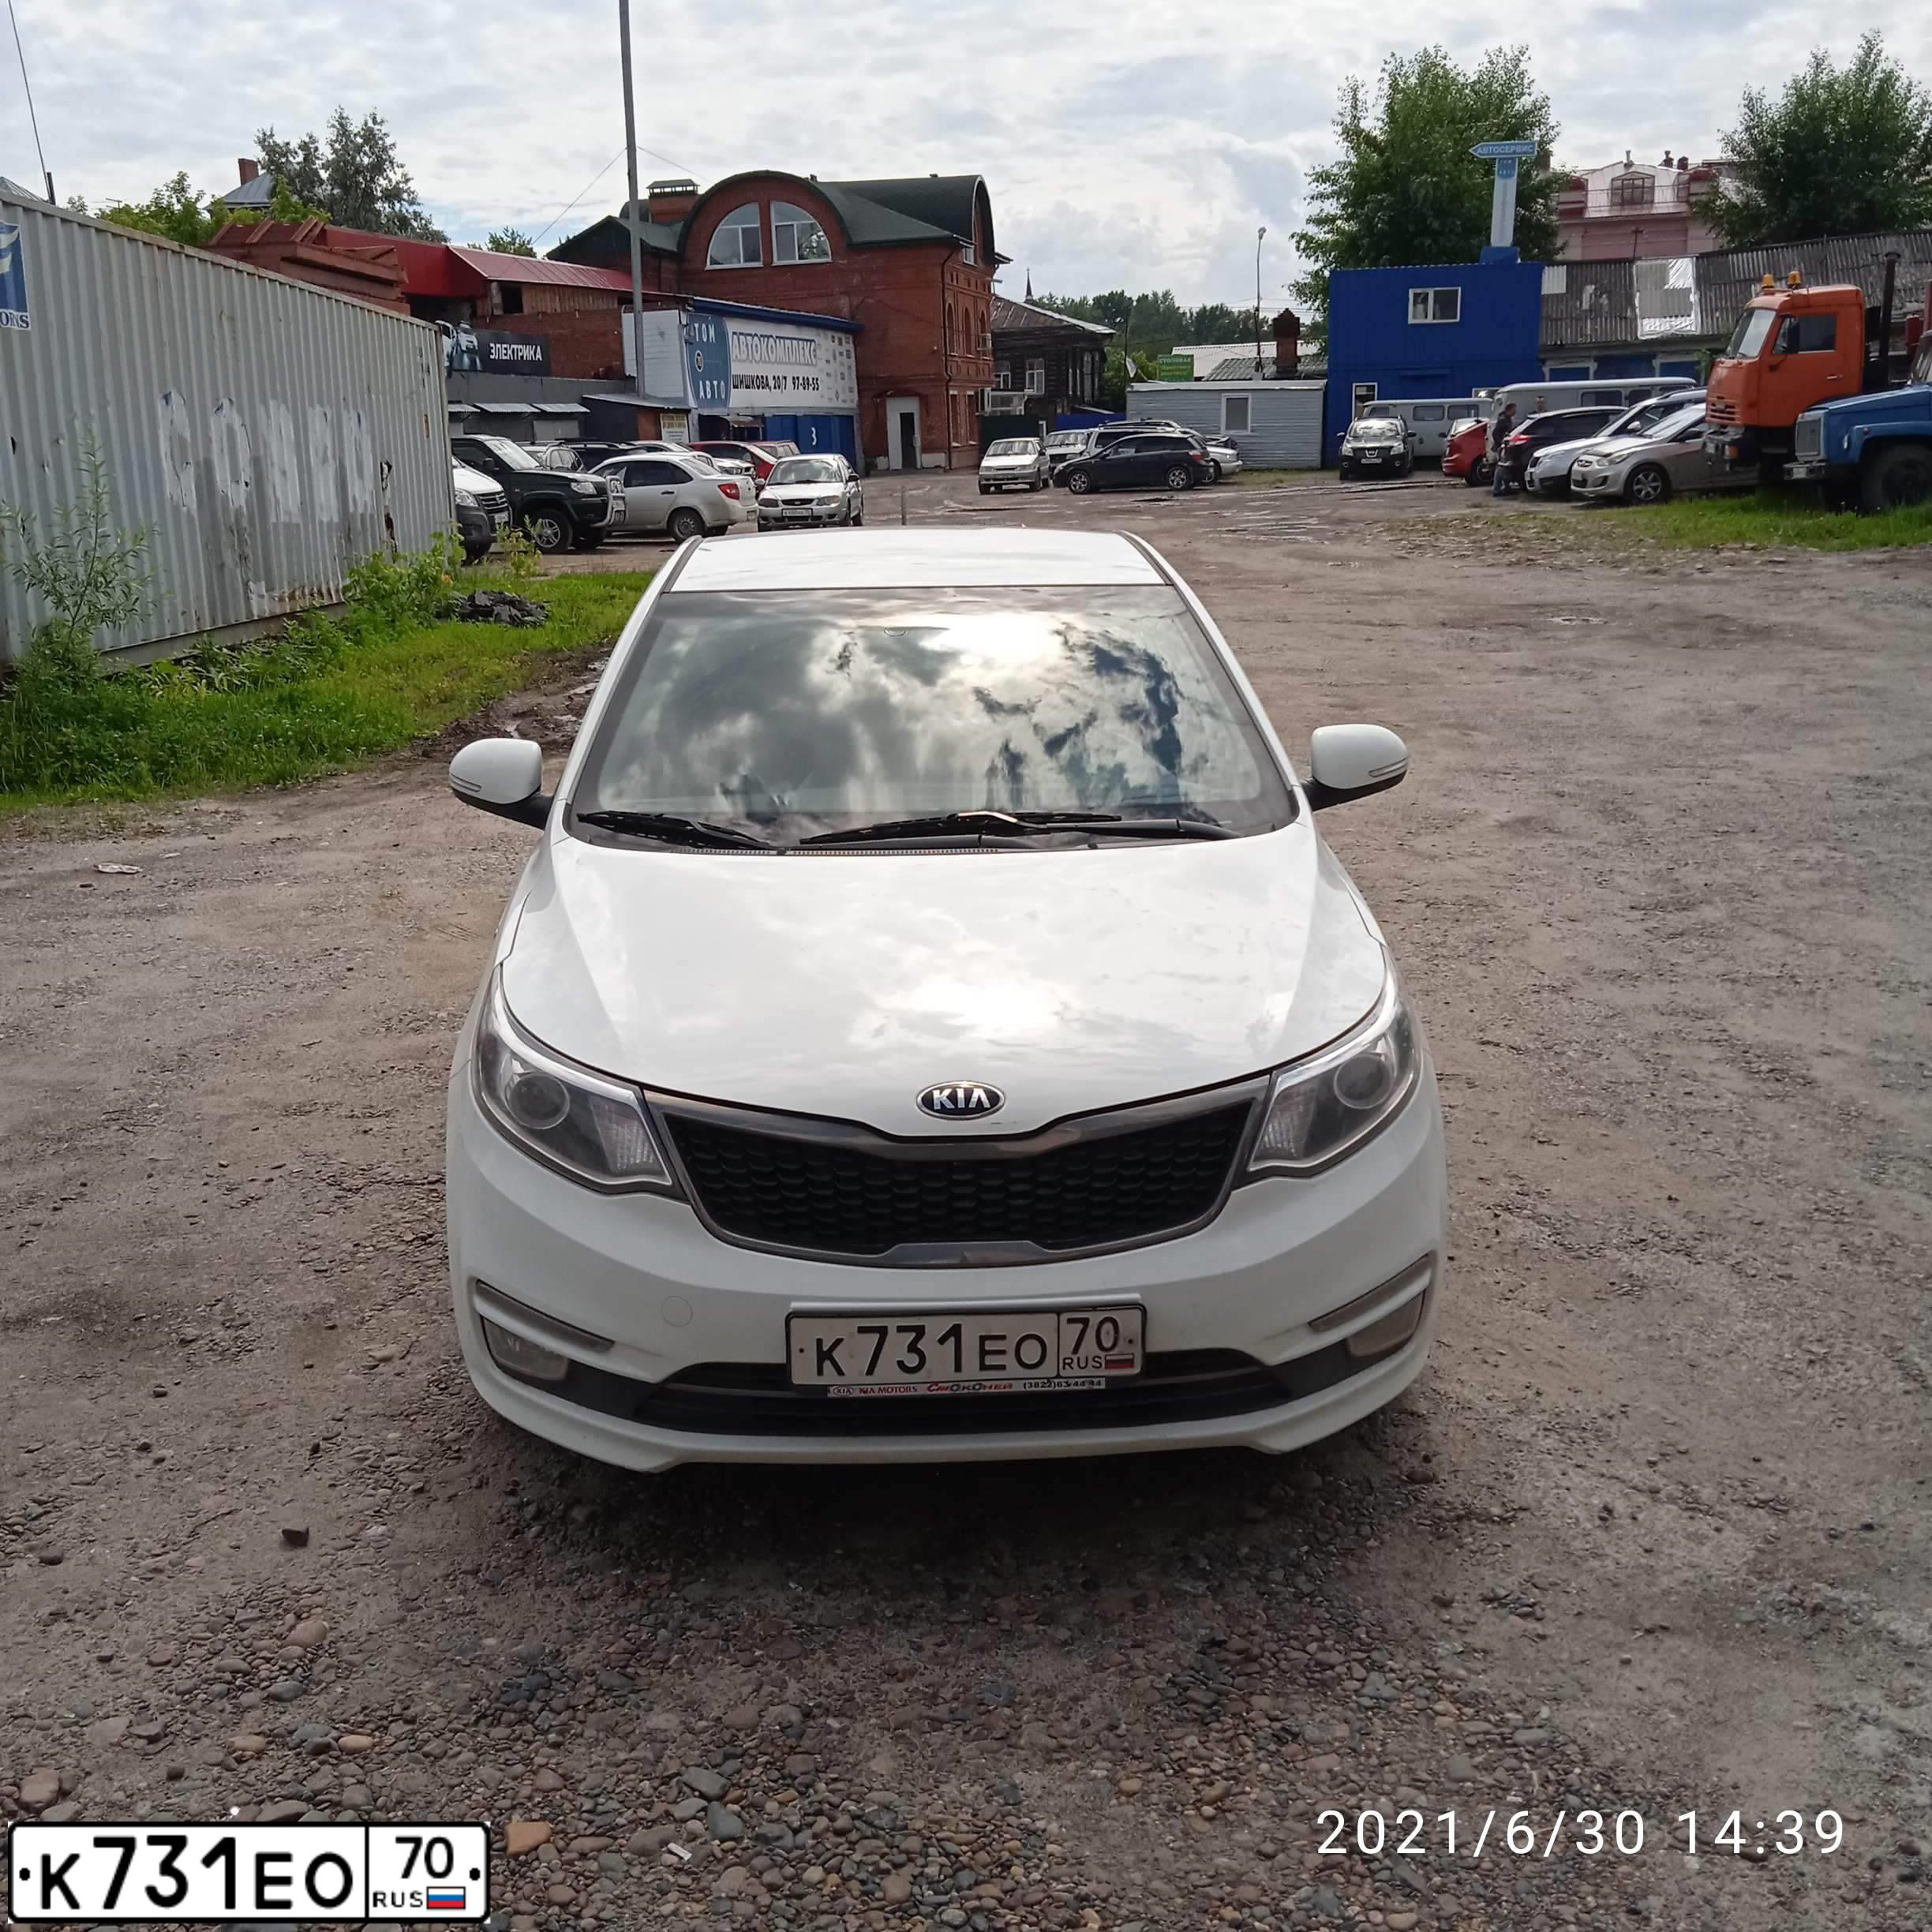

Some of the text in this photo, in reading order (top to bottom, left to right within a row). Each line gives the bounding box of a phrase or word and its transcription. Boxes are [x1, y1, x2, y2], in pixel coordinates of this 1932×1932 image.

[1477, 144, 1534, 154] АВТОСЕРВИС
[489, 343, 543, 361] ЭЛЕКТРИКА
[732, 331, 817, 365] АВТОКОМПЛЕКС
[699, 380, 726, 399] АВТО
[732, 374, 820, 394] ШИШКОВА, 20/7 97-89-55
[811, 427, 818, 446] 3
[932, 1088, 991, 1110] KIA
[1065, 1316, 1120, 1355] 70
[1061, 1355, 1103, 1370] RUS
[878, 1385, 918, 1395] MOTORS
